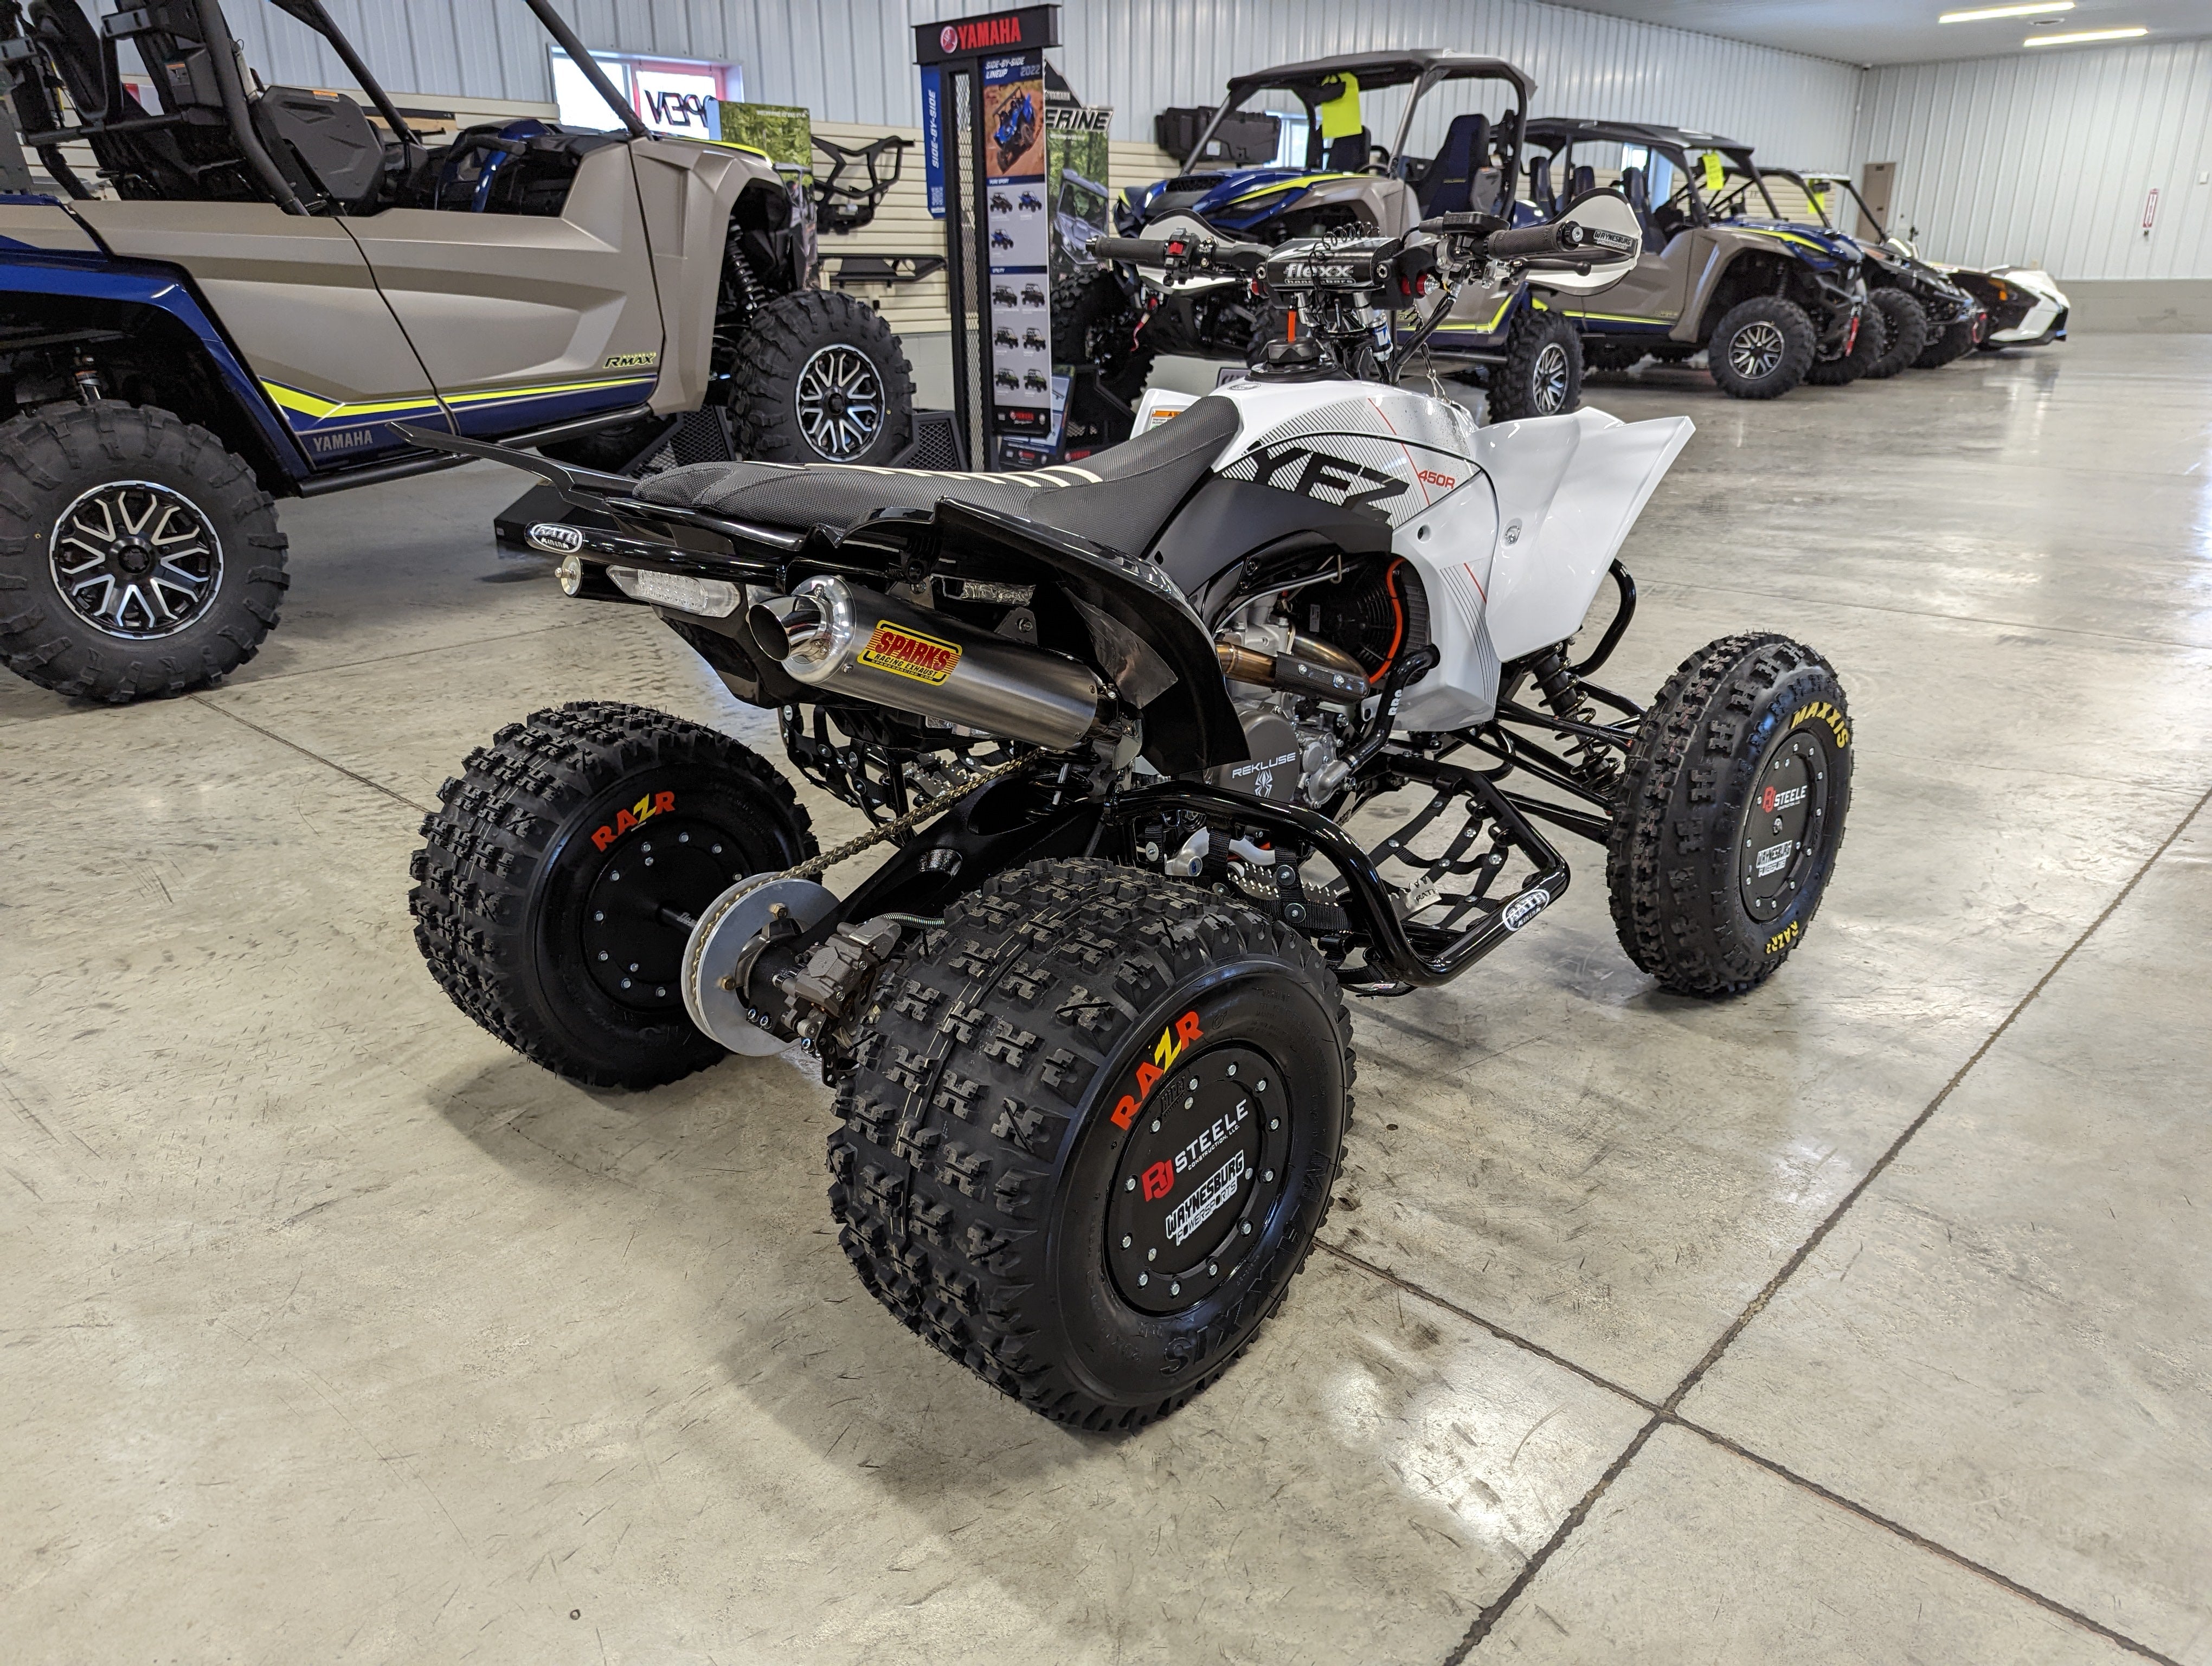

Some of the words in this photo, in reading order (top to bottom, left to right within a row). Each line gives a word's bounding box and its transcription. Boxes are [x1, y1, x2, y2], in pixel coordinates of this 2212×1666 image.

[957, 17, 1021, 50] YAMAHA
[985, 68, 1008, 79] LINEUP
[1020, 64, 1041, 77] 2022
[986, 56, 1026, 70] SIDE-BY-SIDE
[928, 89, 940, 169] SIDE-BY-SIDE
[1594, 230, 1632, 247] WAYNESBURG
[1284, 263, 1354, 278] flexx
[603, 356, 657, 369] RMAX
[313, 430, 374, 452] YAMAHA
[1418, 470, 1456, 489] 450R
[874, 653, 903, 666] RACING
[904, 663, 938, 677] EXHAUST
[875, 631, 951, 671] SPARKS
[1790, 701, 1848, 749] MAXXIS
[1232, 752, 1296, 779] REKLUSE
[1773, 785, 1808, 808] STEELE
[591, 791, 676, 853] RAZR
[1110, 1011, 1204, 1131] RAZR
[1142, 1159, 1174, 1202] RJ
[1175, 1099, 1249, 1174] STEELE
[1188, 1135, 1228, 1171] CONSTRUCTION,
[1229, 1124, 1240, 1136] LLC.
[1166, 1149, 1244, 1240] WAYNESBURG
[1176, 1179, 1238, 1246] POWERSPORTS
